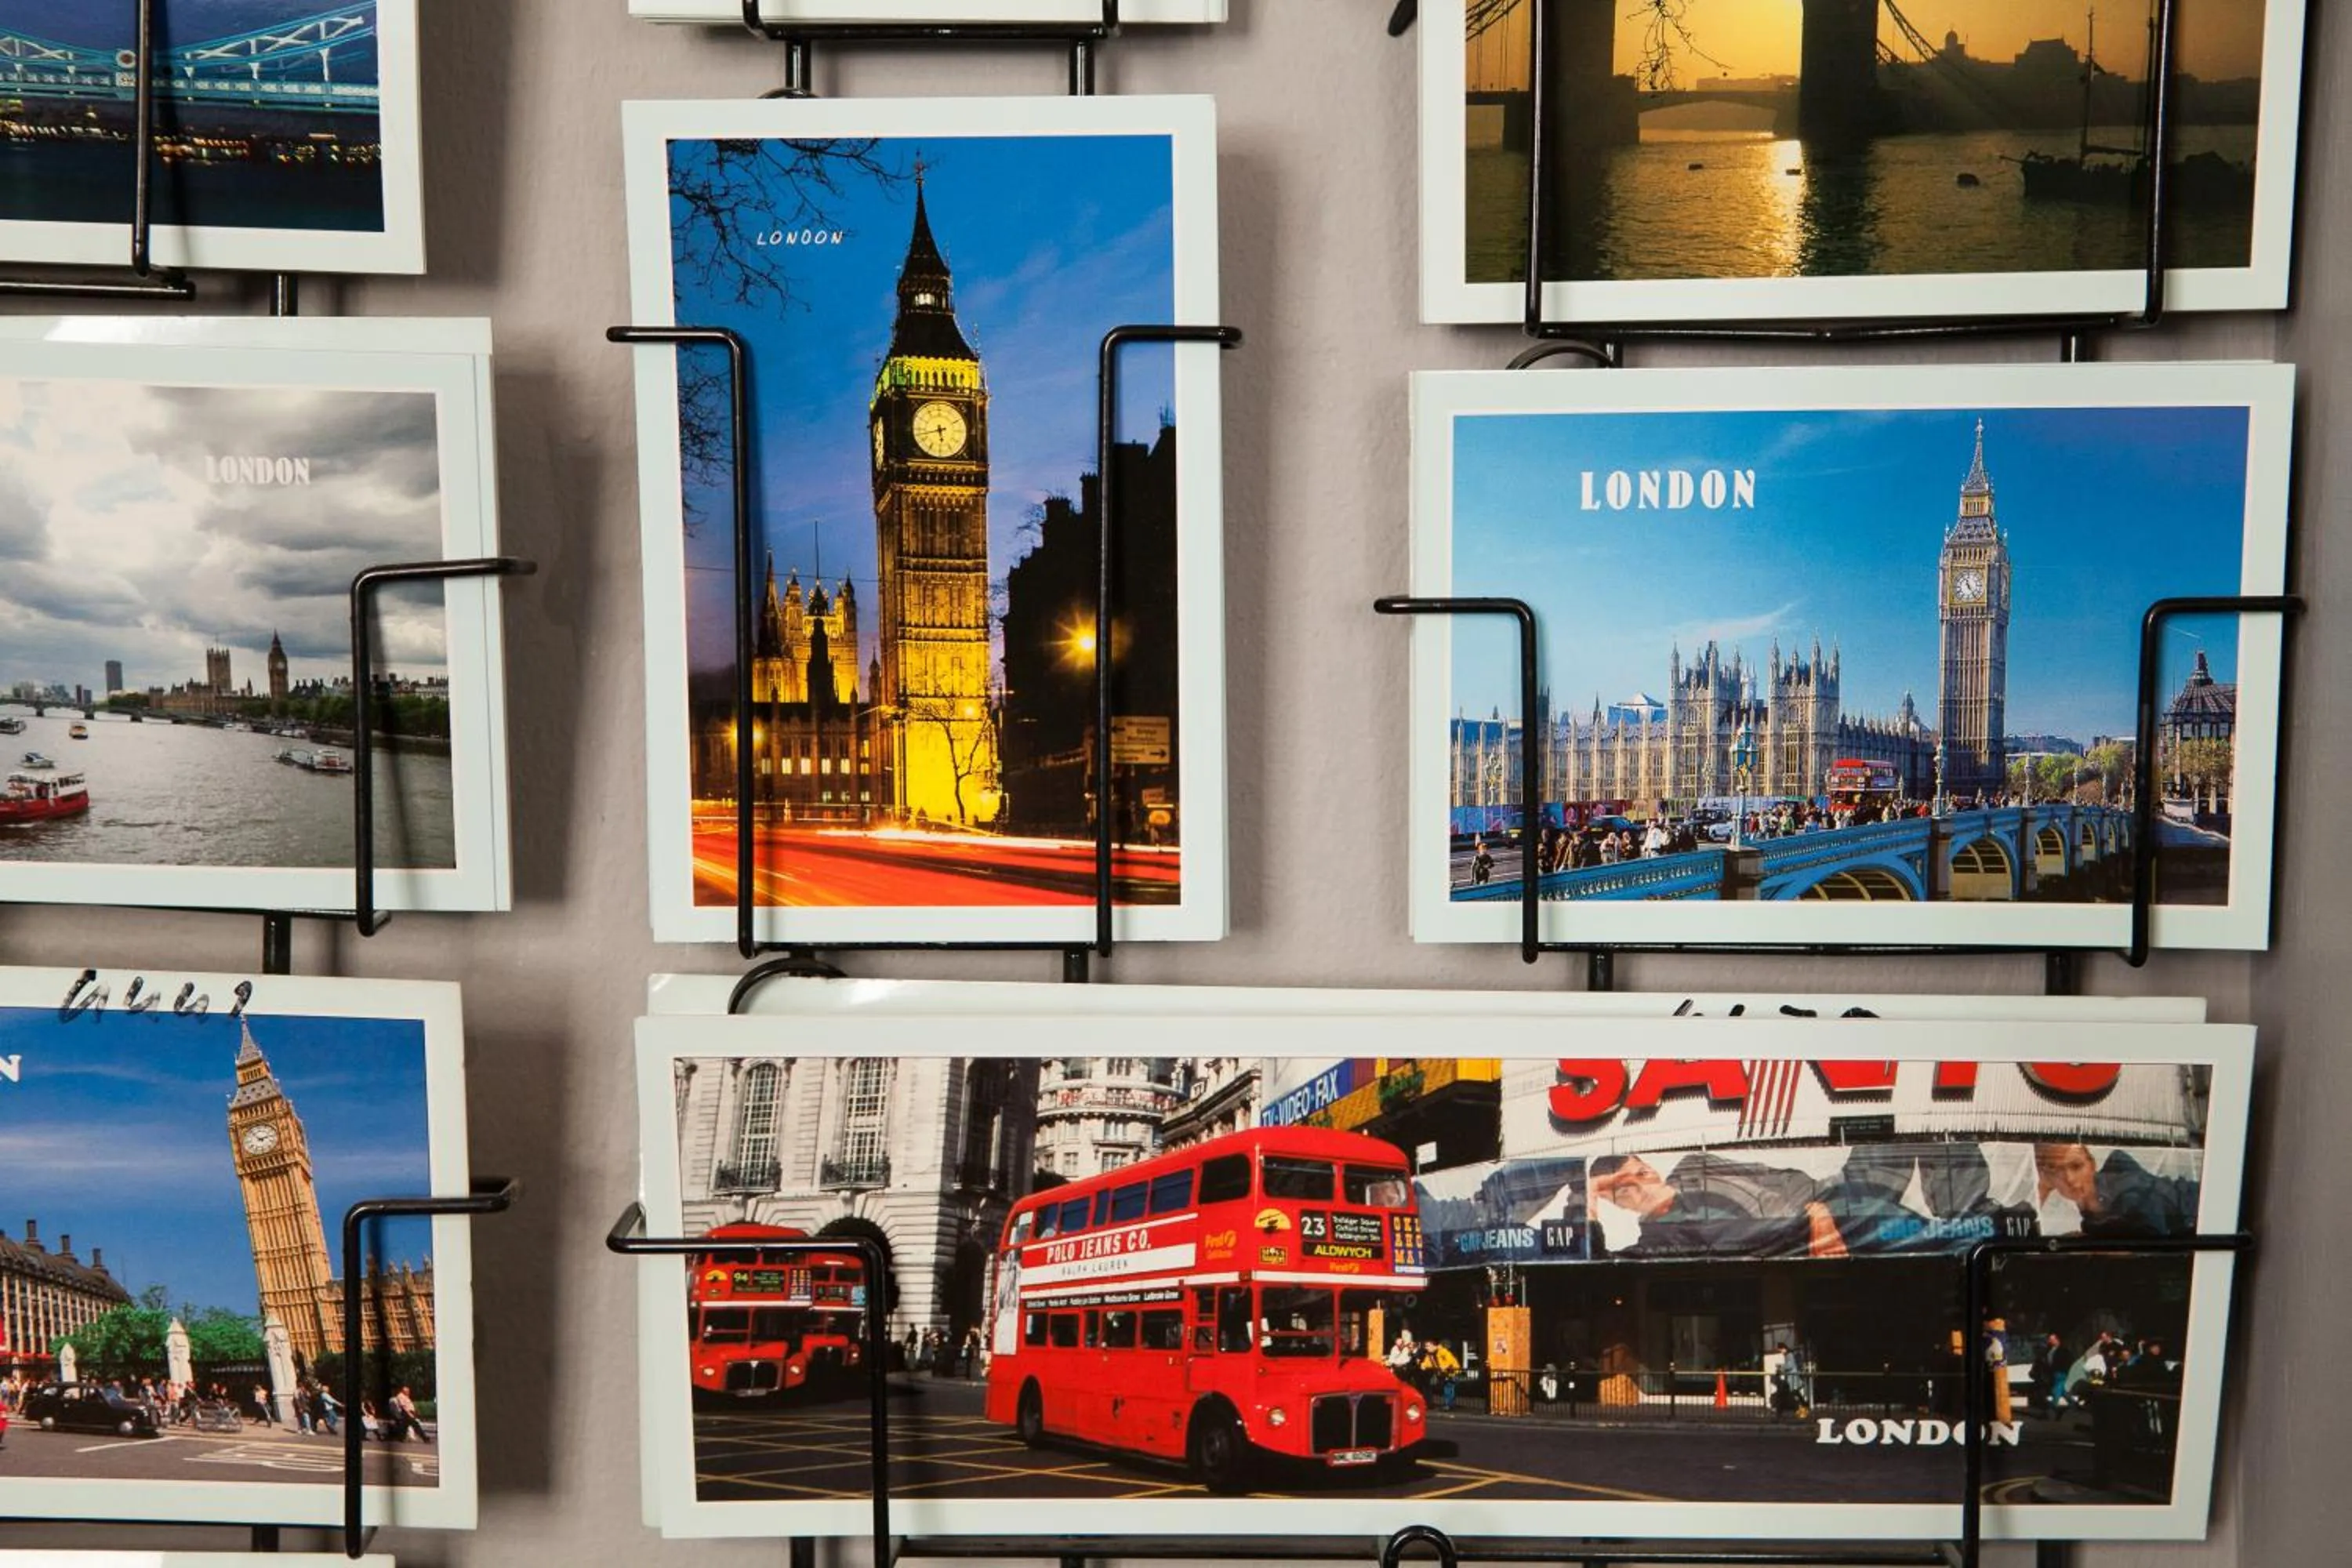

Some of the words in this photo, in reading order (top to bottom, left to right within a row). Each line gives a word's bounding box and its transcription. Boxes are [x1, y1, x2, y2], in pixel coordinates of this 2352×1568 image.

[756, 229, 844, 245] LONDON
[205, 455, 310, 485] LONDON
[1580, 469, 1756, 510] LONDON
[1279, 1087, 1310, 1125] VIDEO
[1315, 1069, 1338, 1109] FAX
[1301, 1216, 1327, 1236] 23
[1547, 1226, 1573, 1247] GAP
[1923, 1216, 1994, 1238] JEANS
[2006, 1216, 2030, 1237] GAP
[1046, 1244, 1075, 1263] POLO
[1080, 1235, 1121, 1258] JEANS
[1127, 1229, 1152, 1251] CO.
[1482, 1228, 1534, 1249] JEANS
[1314, 1244, 1371, 1258] ALDWYCH
[734, 1273, 748, 1283] 94
